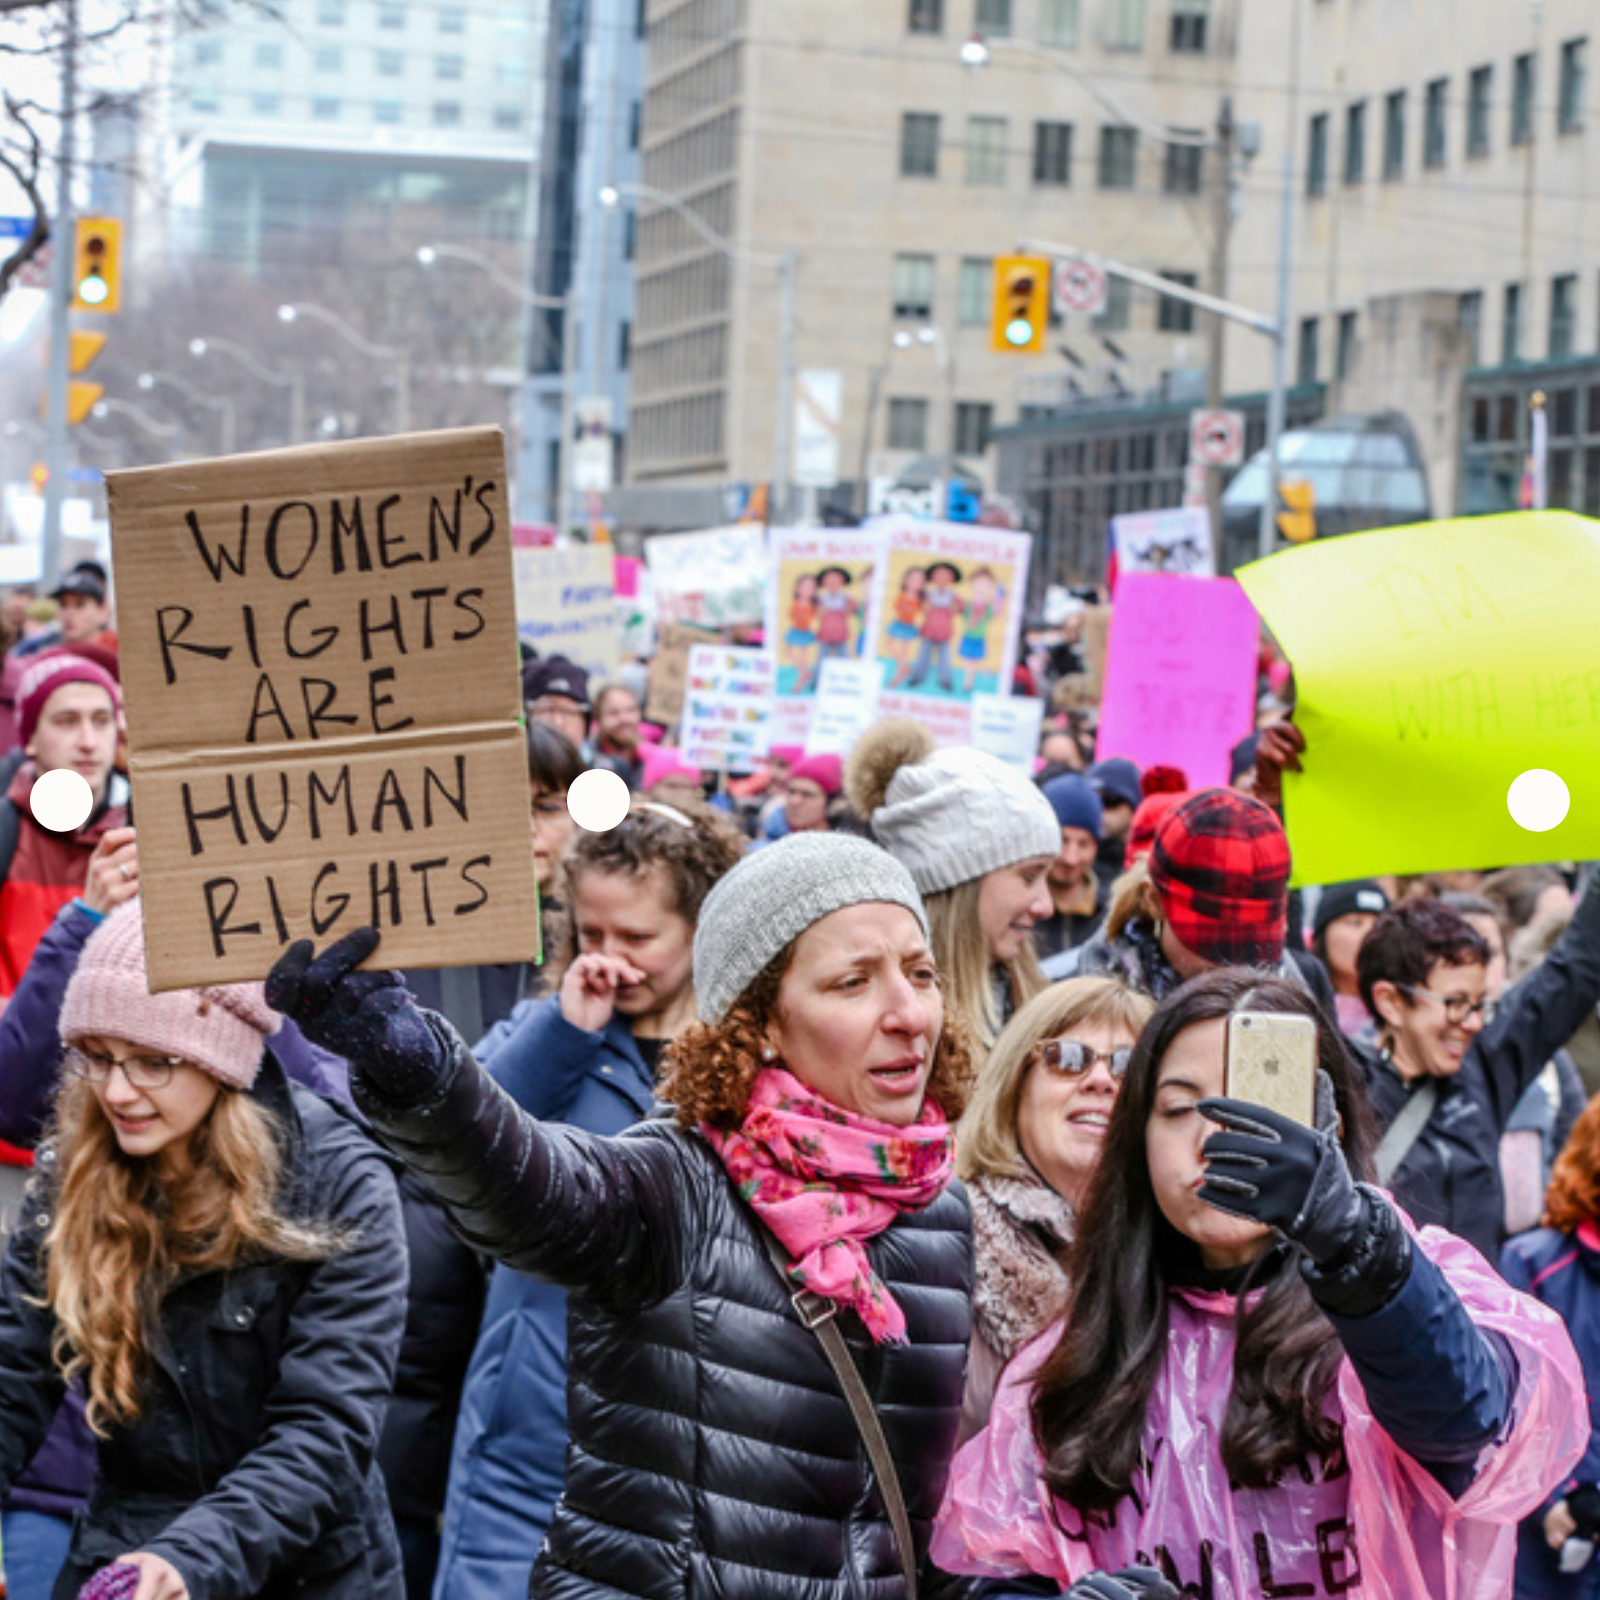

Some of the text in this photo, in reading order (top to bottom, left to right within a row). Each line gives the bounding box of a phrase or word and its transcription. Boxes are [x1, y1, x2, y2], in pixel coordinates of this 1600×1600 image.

[184, 474, 496, 582] WOMEN'S
[156, 586, 485, 686] RIGHTS
[244, 666, 415, 743] ARE
[1390, 668, 1502, 740] WITH
[181, 755, 469, 857] HUMAN
[204, 855, 492, 957] RIGHTS
